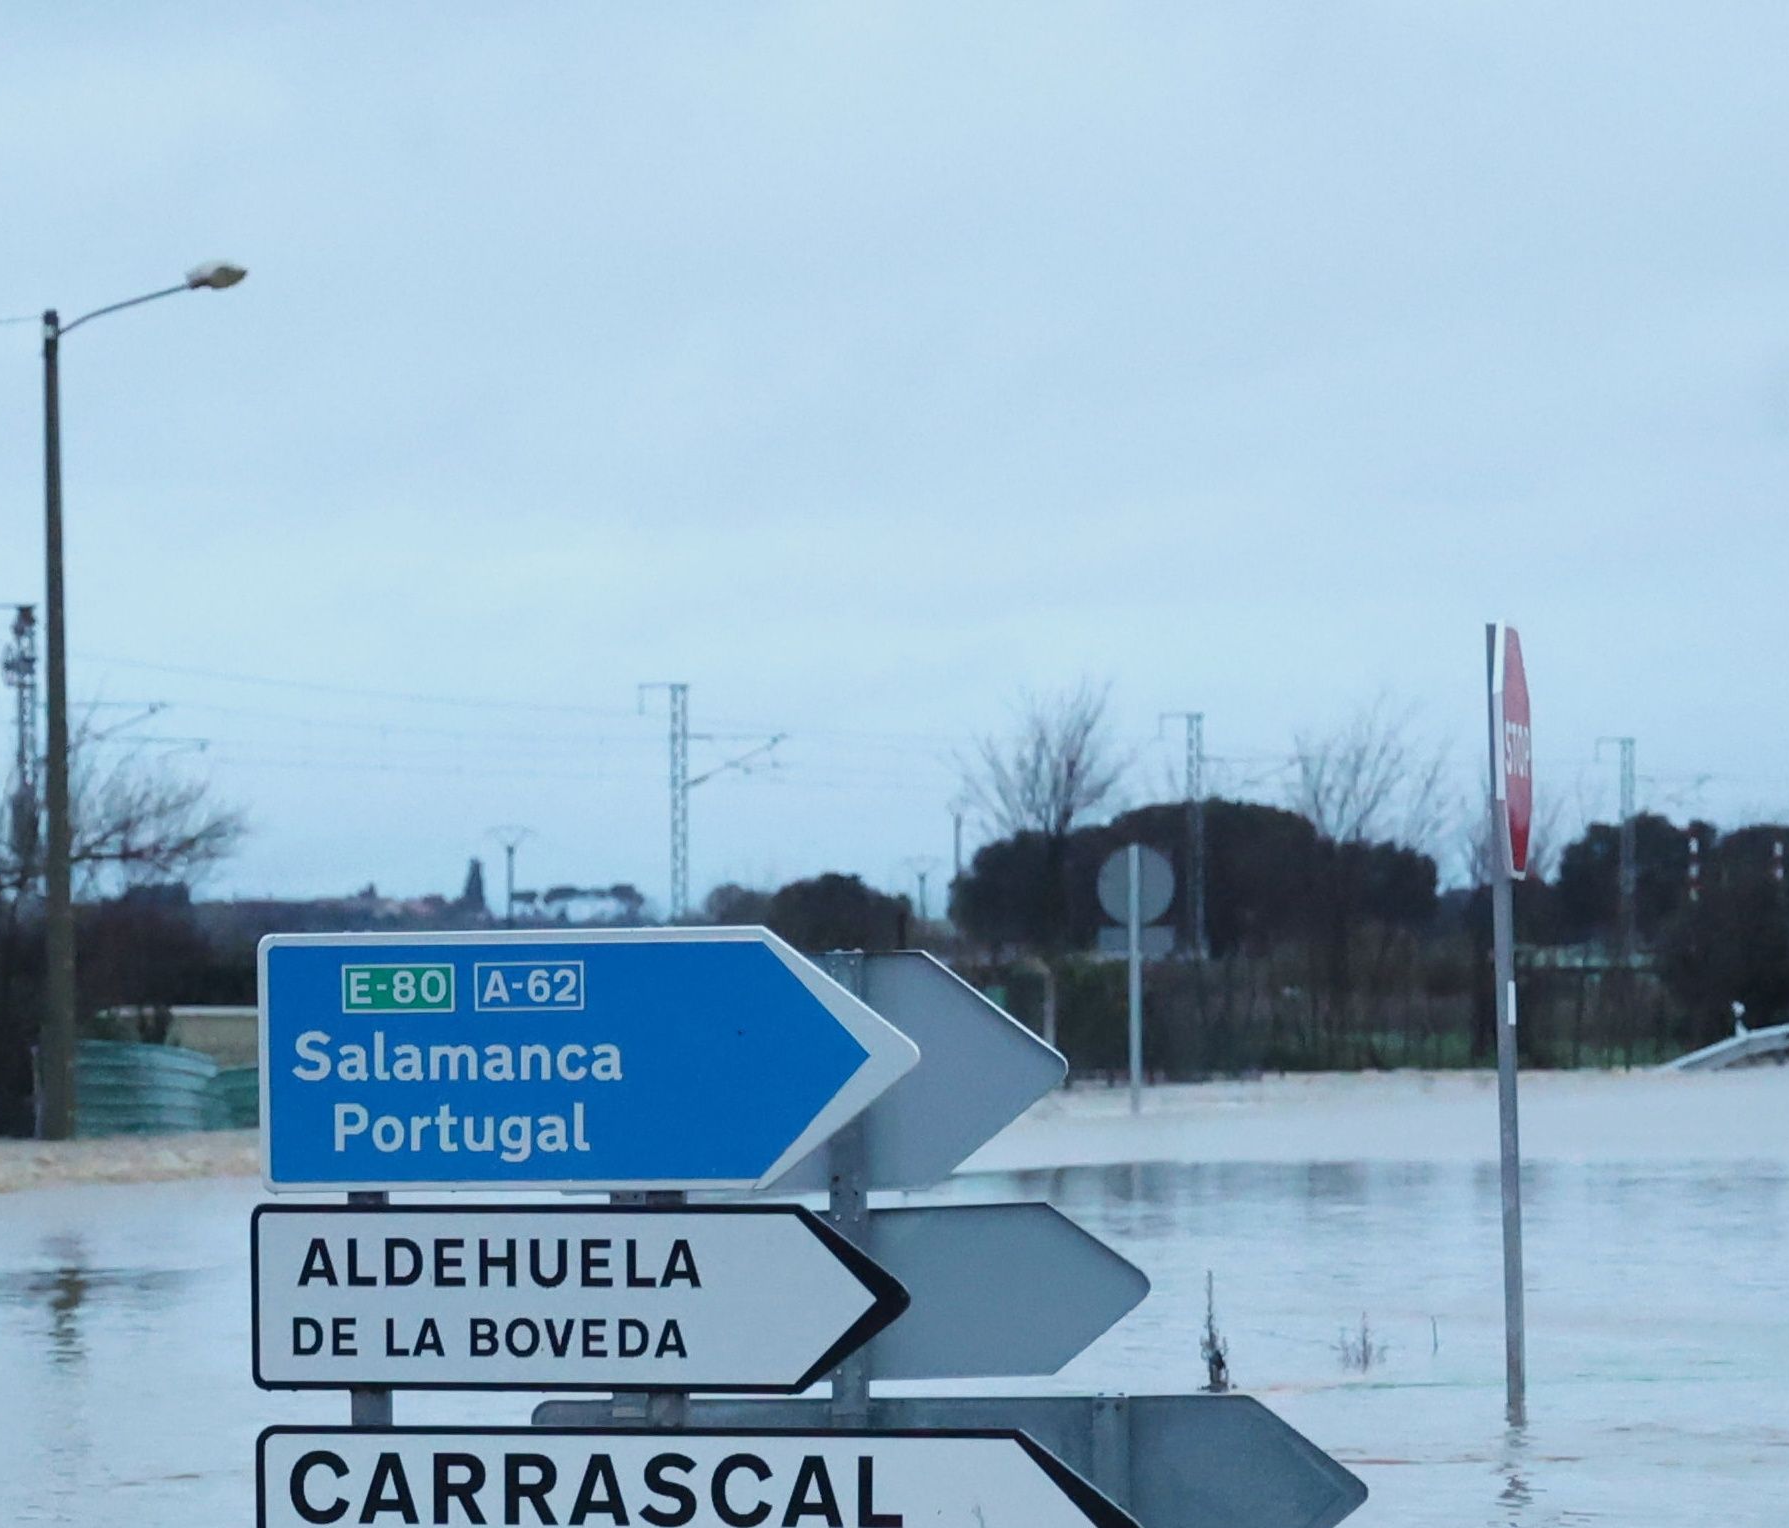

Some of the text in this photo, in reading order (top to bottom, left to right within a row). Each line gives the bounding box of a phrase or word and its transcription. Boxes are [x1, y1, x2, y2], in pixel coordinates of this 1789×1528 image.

[348, 968, 579, 1004] E-80 A-62
[292, 1031, 623, 1081] Salamanca
[335, 1103, 590, 1162] Portugal
[298, 1238, 701, 1288] ALDEHUELA
[293, 1317, 687, 1358] DE LA BOVEDA
[290, 1451, 902, 1528] CARRASCAL
